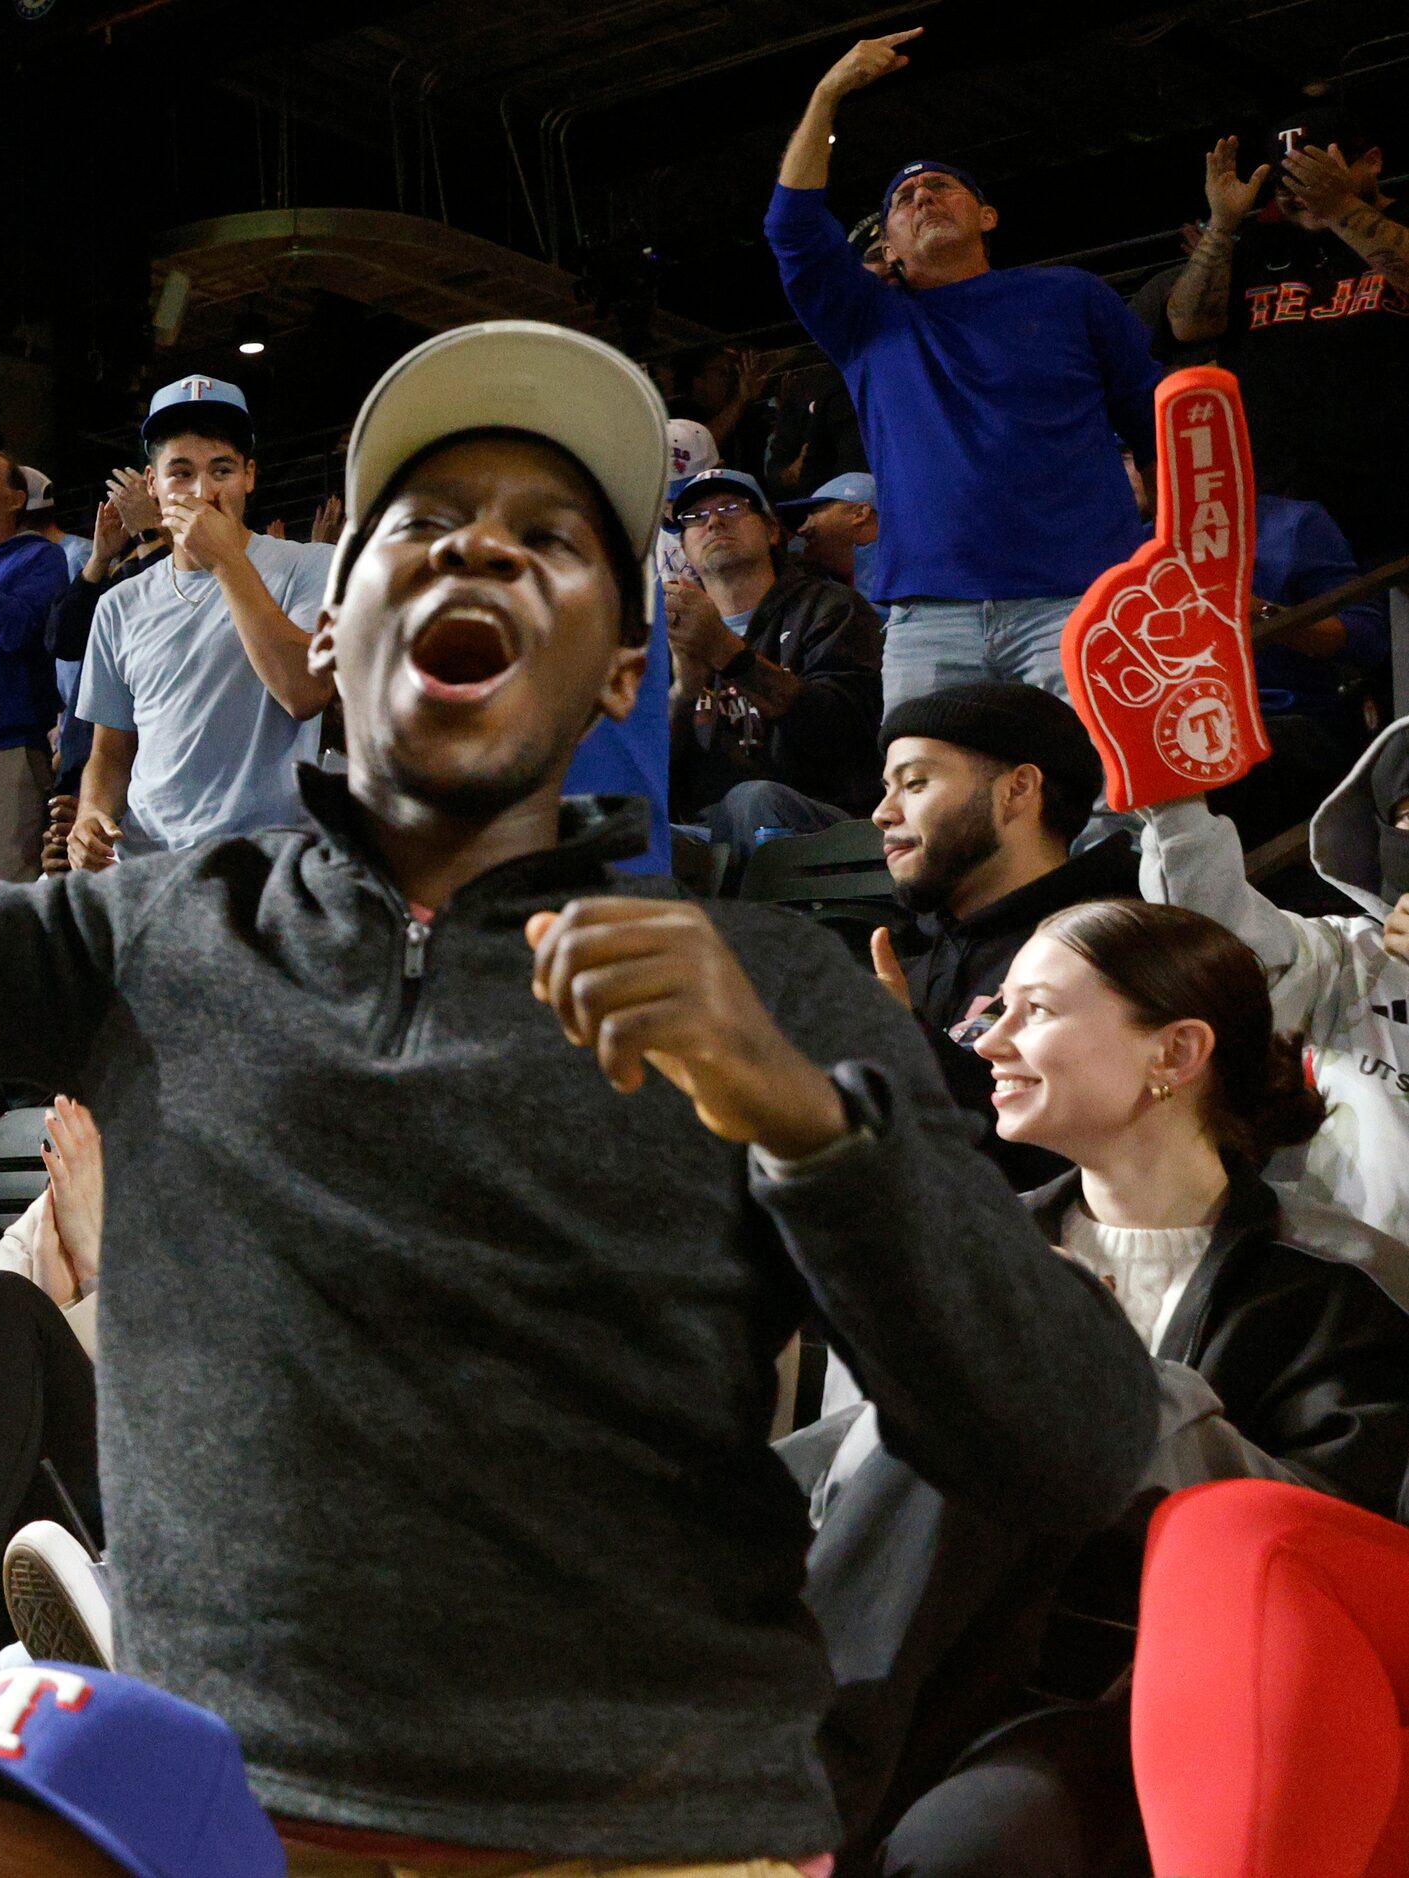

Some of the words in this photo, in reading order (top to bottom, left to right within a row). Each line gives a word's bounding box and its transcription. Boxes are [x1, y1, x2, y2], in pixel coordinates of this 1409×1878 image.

[1278, 127, 1303, 155] T
[180, 378, 213, 401] T
[1190, 469, 1231, 565] FAN
[1189, 707, 1223, 755] T
